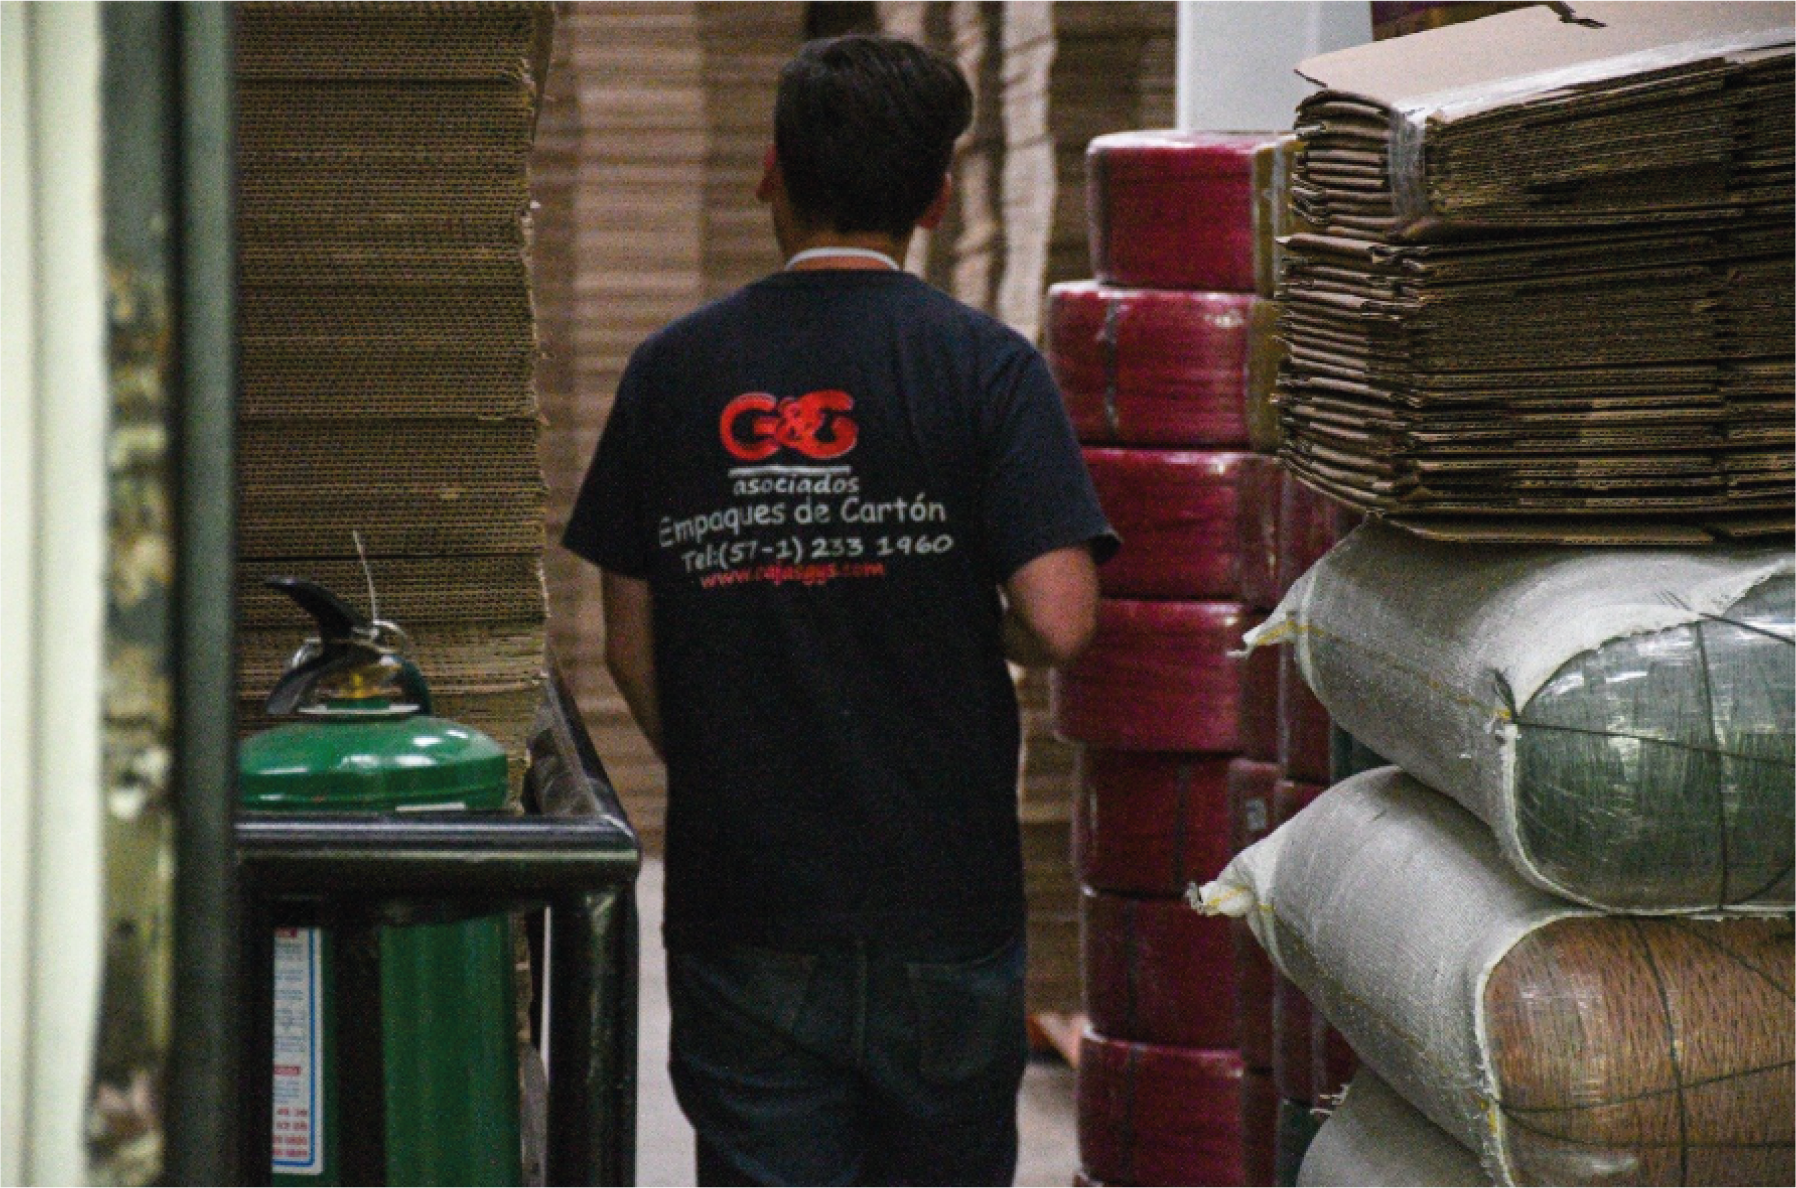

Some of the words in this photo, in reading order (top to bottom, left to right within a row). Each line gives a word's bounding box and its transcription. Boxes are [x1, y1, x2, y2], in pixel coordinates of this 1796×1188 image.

[720, 390, 858, 460] G&G
[733, 474, 859, 496] asociados
[659, 500, 785, 547] Empaques
[794, 496, 831, 524] de
[841, 491, 947, 523] Cartón
[811, 537, 864, 559] 233
[876, 533, 955, 556] 1960
